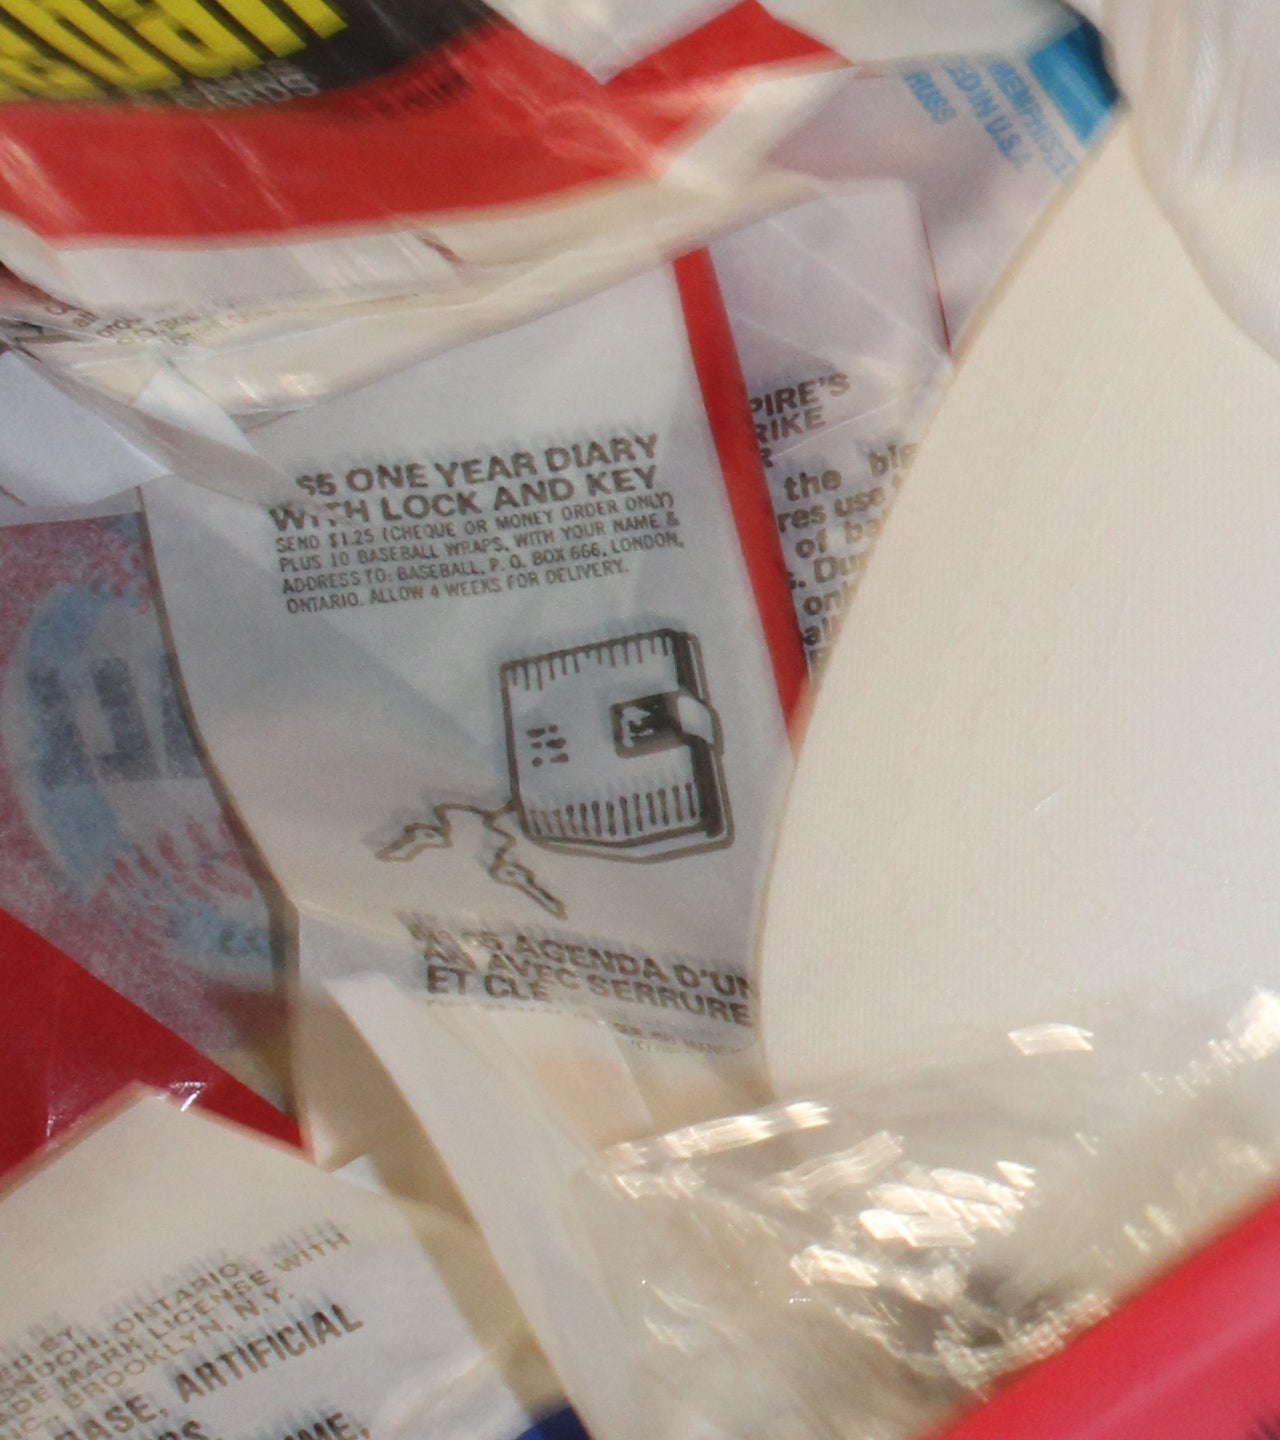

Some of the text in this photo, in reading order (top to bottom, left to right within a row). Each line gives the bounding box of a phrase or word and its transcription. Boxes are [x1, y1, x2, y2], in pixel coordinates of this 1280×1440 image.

[346, 462, 429, 493] ONE
[434, 451, 538, 488] YEAR
[544, 432, 659, 472] DIARY
[784, 469, 843, 502] the
[380, 490, 483, 521] LOCK
[493, 476, 575, 511] AND
[585, 463, 658, 498] KEY
[275, 535, 320, 554] SEND
[382, 521, 457, 542] (CHEQUE
[464, 519, 488, 536] OR
[495, 509, 553, 531] MONEY
[560, 498, 618, 521] ORDER
[625, 490, 675, 511] ONLY)
[279, 554, 323, 573] PLUS
[330, 552, 350, 568] 10
[357, 543, 439, 565] BASEBALL
[513, 528, 555, 548] WITH
[560, 522, 606, 541] YOUR
[613, 513, 660, 533] NAME
[666, 510, 680, 527] &
[795, 527, 828, 559] of
[283, 570, 361, 594] ADDRESS
[532, 548, 565, 567] BOX
[370, 585, 424, 605] ALLOW
[430, 584, 441, 598] 4
[444, 576, 501, 597] WEEKS
[506, 571, 539, 591] FOR
[545, 557, 630, 585] DELIVERY.
[427, 964, 468, 995] ET
[516, 934, 669, 982] AGENDA
[587, 974, 753, 1028] SERRURE
[112, 1261, 242, 1335] ONTARIO
[147, 1269, 271, 1341] LICENSE
[174, 1302, 364, 1405] ARTIFICIAL
